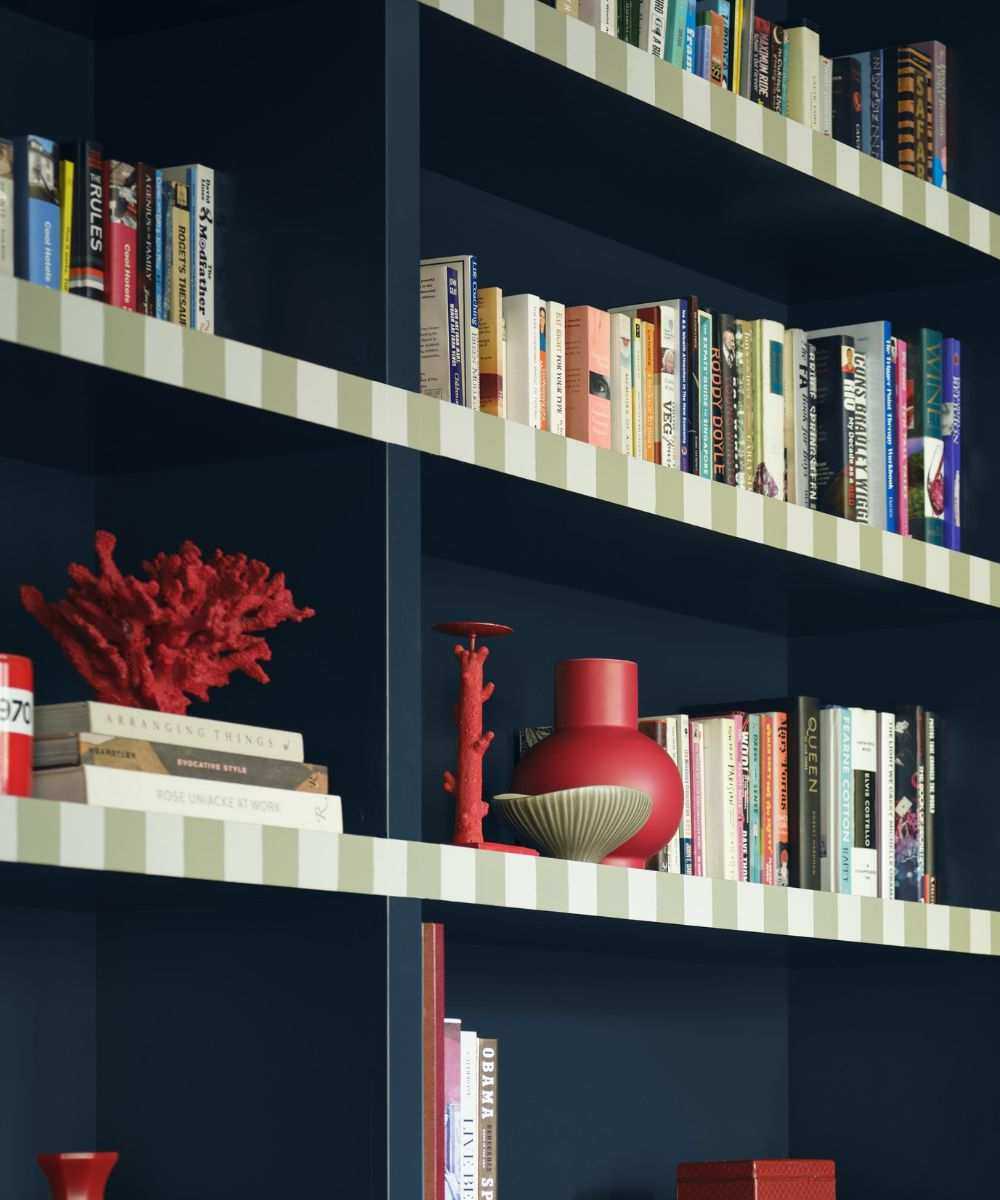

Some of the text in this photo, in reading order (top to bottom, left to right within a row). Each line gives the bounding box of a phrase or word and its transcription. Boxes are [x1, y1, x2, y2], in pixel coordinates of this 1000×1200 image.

[758, 32, 770, 98] MAXIMUM RIDE
[89, 183, 103, 252] RULES
[44, 221, 53, 282] Cool Hotels
[123, 243, 132, 304] Cool Hotels
[144, 240, 153, 281] FAMILY
[178, 225, 187, 273] ROGET'S
[199, 224, 208, 316] Modfather
[799, 364, 809, 389] FA
[843, 379, 856, 410] RIO
[926, 344, 944, 425] WINE
[663, 400, 673, 435] VEG
[711, 347, 725, 476] RODDY DOYLE
[855, 403, 868, 474] BRADLEY
[106, 714, 275, 749] ARRANGING THINGS
[777, 720, 789, 753] Mary
[806, 716, 818, 794] QUEEN
[840, 716, 851, 773] FEARNE
[176, 757, 248, 774] EVOCATIVE STYLE
[841, 778, 851, 843] COTTON
[481, 1047, 496, 1120] OBAMA
[462, 1119, 475, 1167] LIVE
